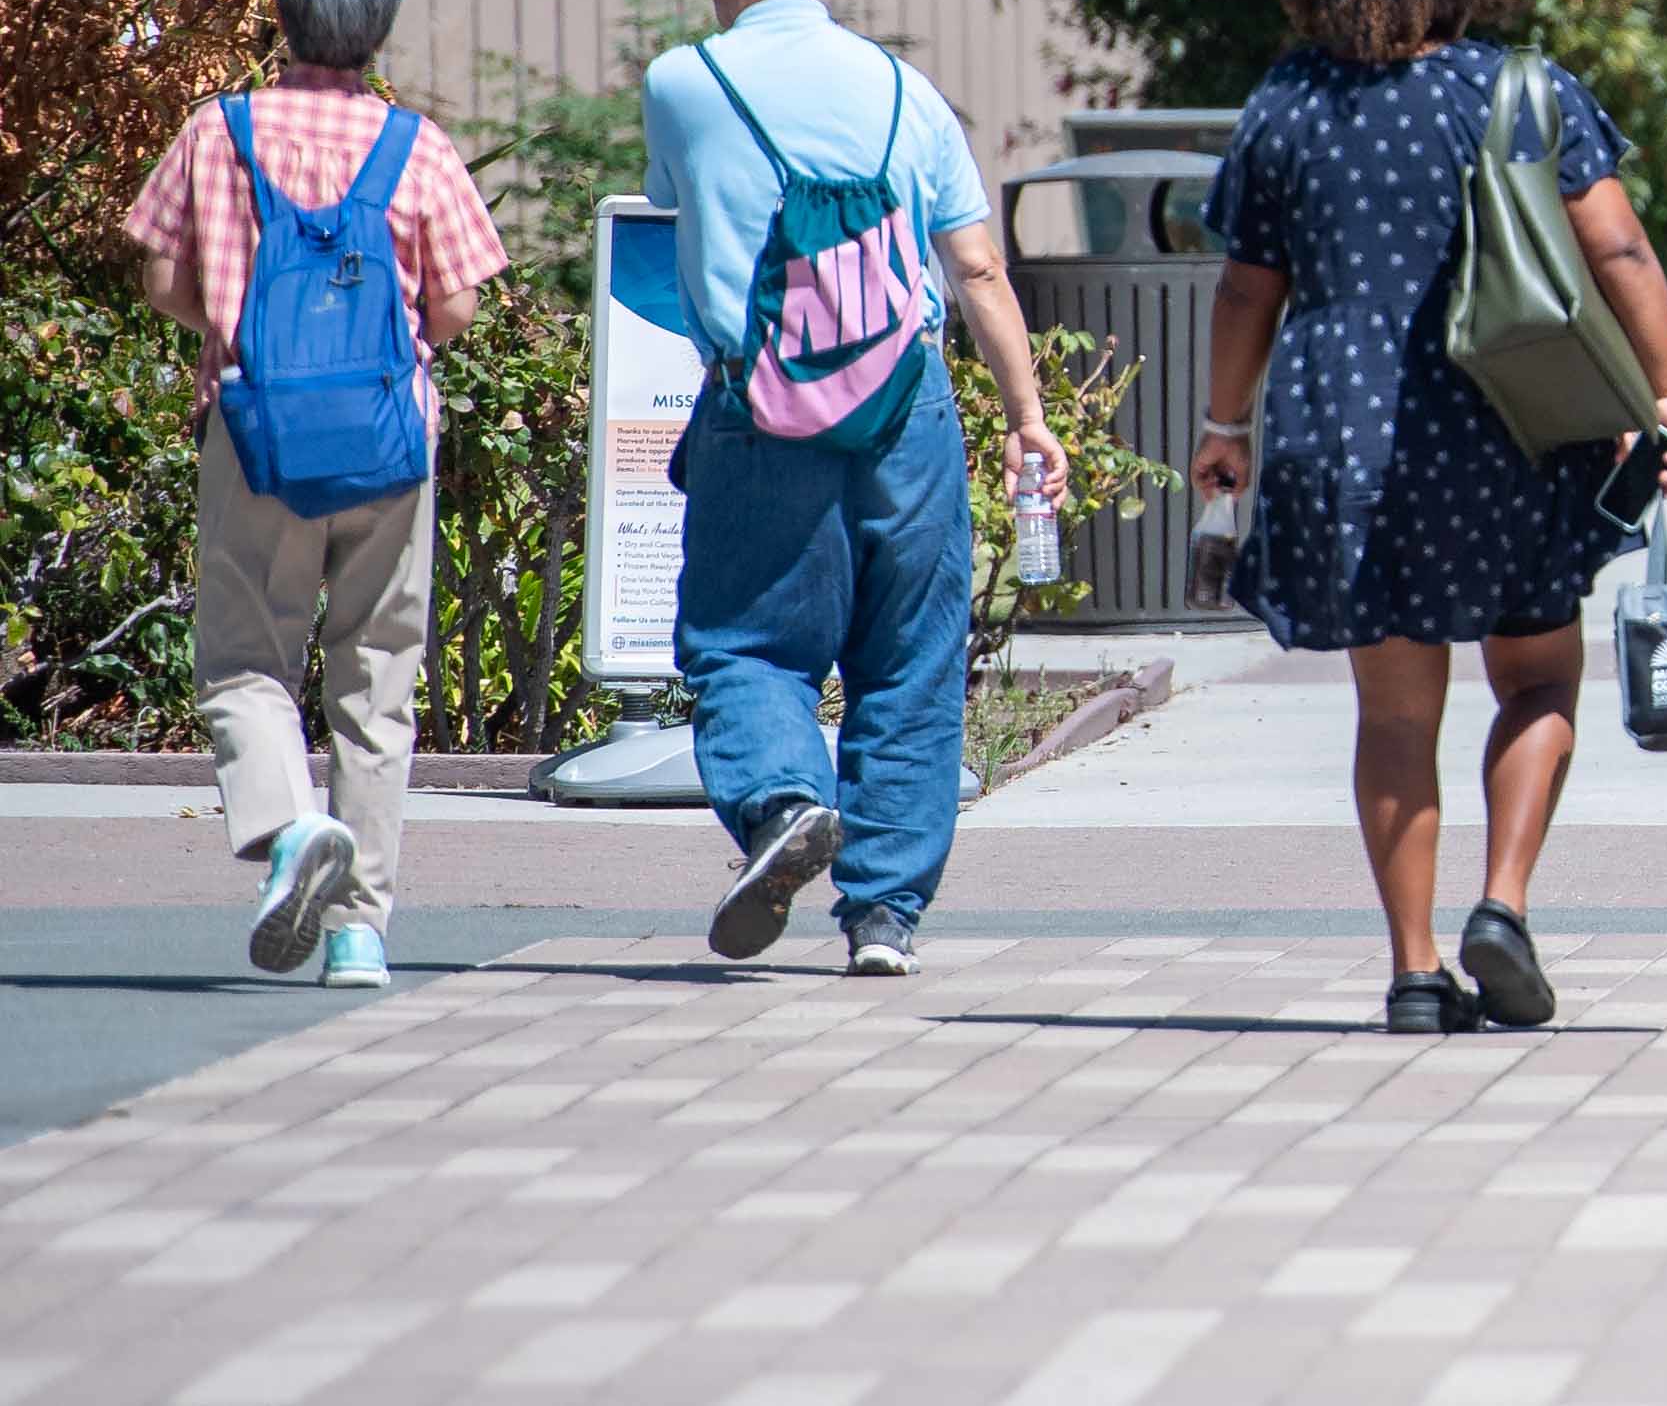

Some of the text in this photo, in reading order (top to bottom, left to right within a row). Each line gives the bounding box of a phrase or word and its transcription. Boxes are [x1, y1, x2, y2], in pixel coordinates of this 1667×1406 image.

[778, 207, 923, 361] NIK
[652, 394, 695, 408] MISS
[617, 427, 641, 435] Thanks
[643, 427, 649, 435] to
[617, 437, 644, 445] Harvest
[646, 437, 663, 445] Food
[617, 446, 634, 454] have
[636, 446, 647, 454] the
[616, 489, 635, 497] Open
[637, 489, 669, 497] Mondays
[617, 522, 648, 535] What's
[624, 540, 638, 549] Dry
[639, 540, 653, 548] and
[621, 588, 641, 596] Bring
[643, 587, 658, 595] Your
[613, 616, 637, 624] Follow
[629, 638, 673, 647] missionco
